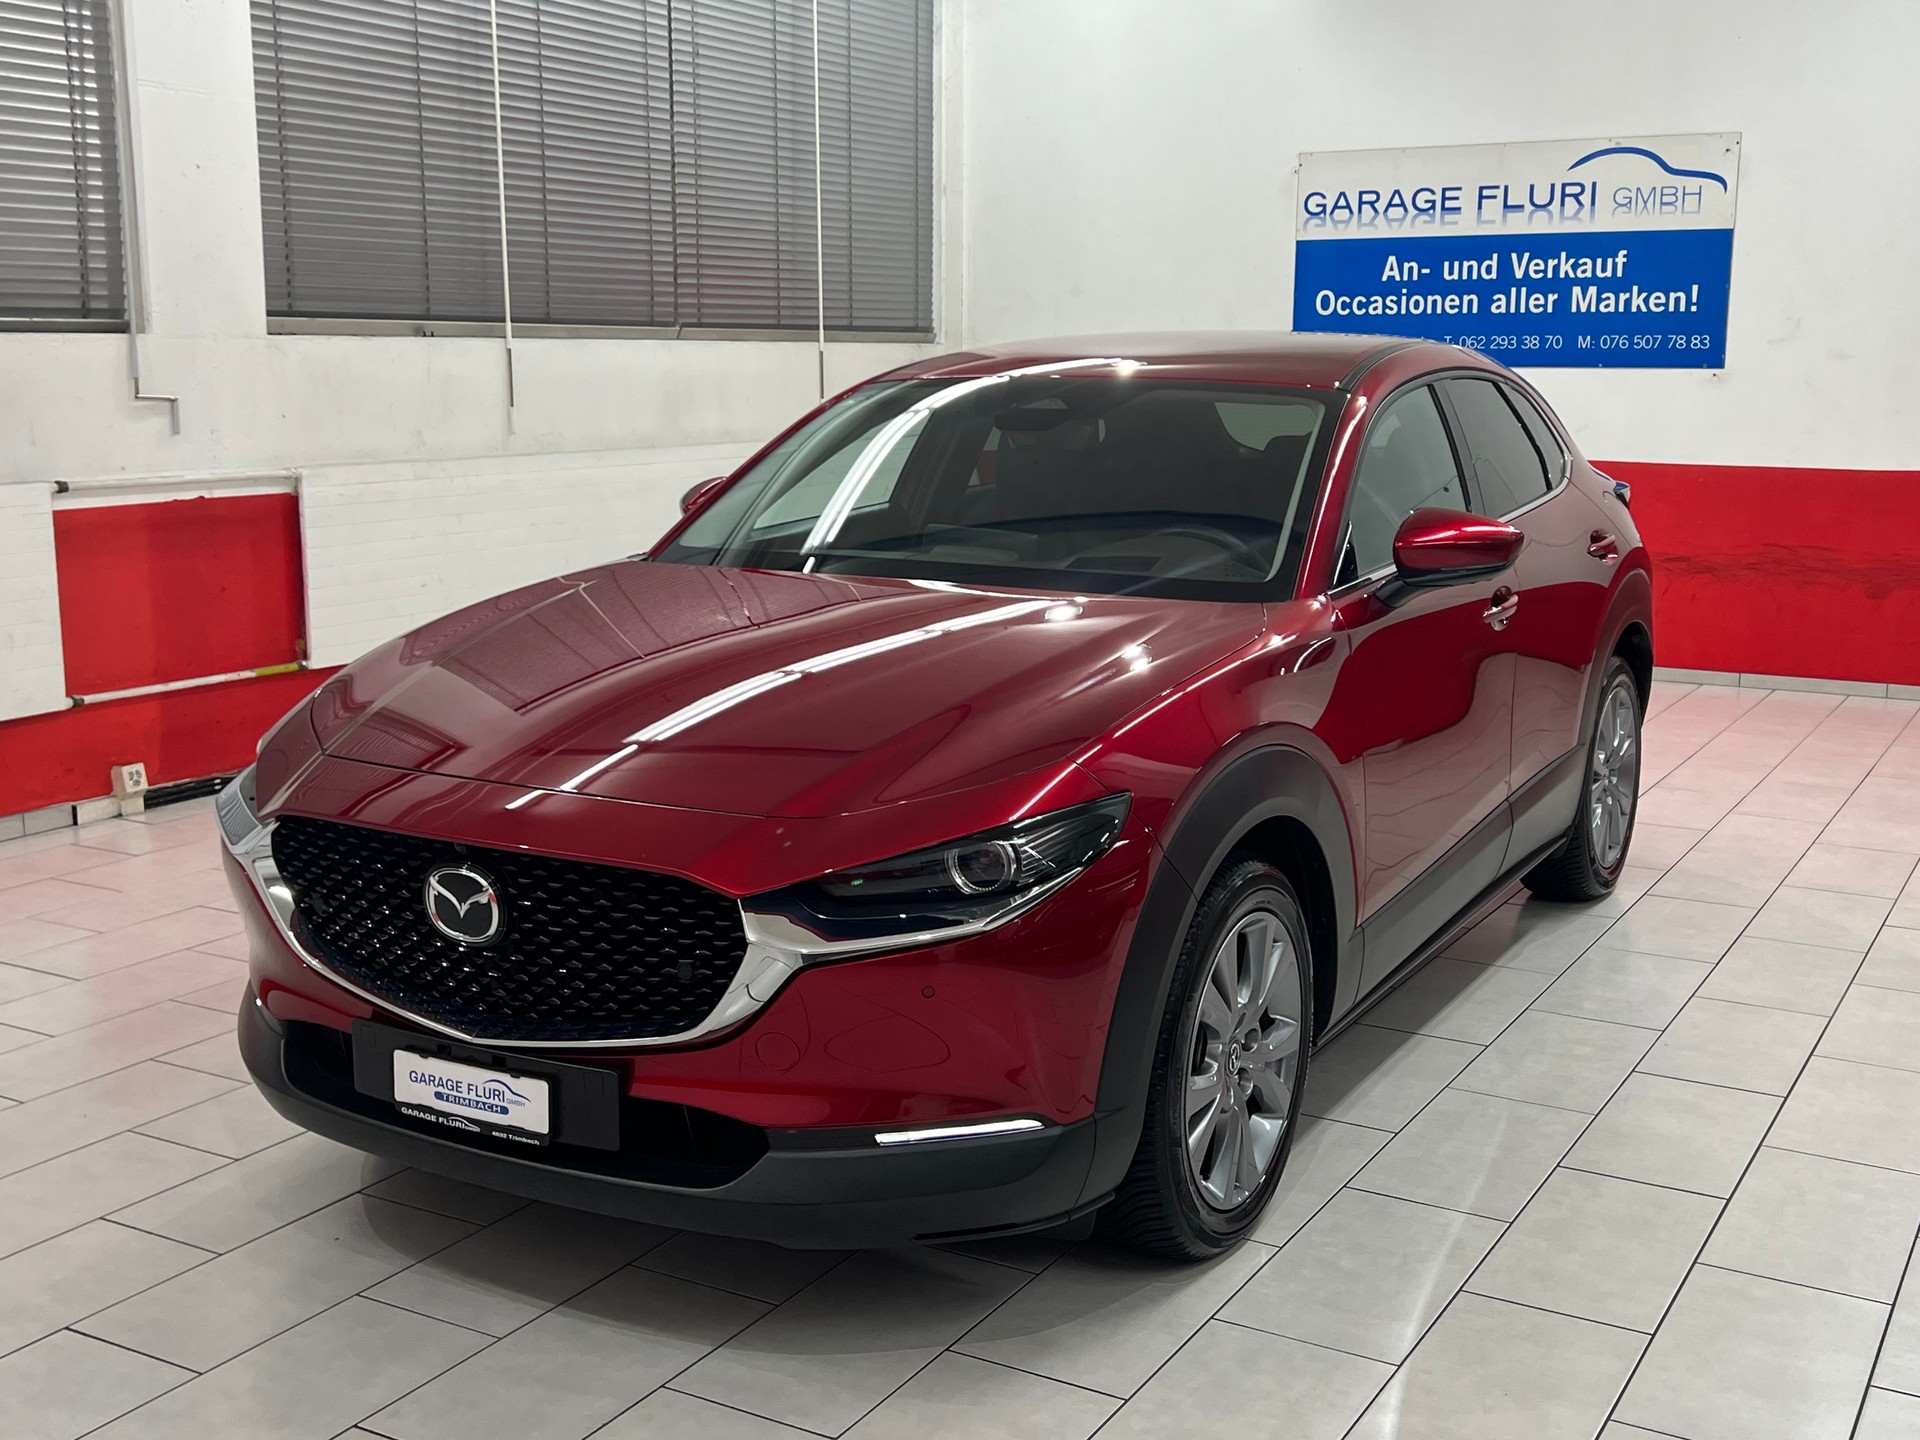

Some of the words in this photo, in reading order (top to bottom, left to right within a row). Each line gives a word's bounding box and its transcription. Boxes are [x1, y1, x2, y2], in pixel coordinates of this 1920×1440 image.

[1303, 186, 1463, 217] GARAGE
[1477, 181, 1597, 212] FLURI
[1612, 185, 1703, 209] GMBH
[1381, 255, 1431, 281] An-
[1443, 252, 1498, 280] und
[1511, 249, 1628, 279] Verkauf
[1315, 288, 1479, 316] Occasionen
[1491, 286, 1558, 314] aller
[1571, 284, 1699, 313] Marken!
[1459, 335, 1486, 349] 062
[1490, 335, 1517, 349] 293
[1521, 335, 1540, 349] 38
[1545, 335, 1563, 349] 70
[1577, 335, 1595, 349] M:
[1600, 335, 1629, 349] 076
[1633, 335, 1662, 349] 507
[1667, 335, 1687, 349] 78
[1690, 335, 1711, 349] 83
[409, 1070, 463, 1093] GARAGE
[467, 1083, 505, 1103] FLURI
[442, 1092, 501, 1114] TRIMBACH
[401, 1106, 437, 1122] GARAGE
[438, 1116, 465, 1129] FLURI
[508, 1134, 540, 1146] Trimbach
